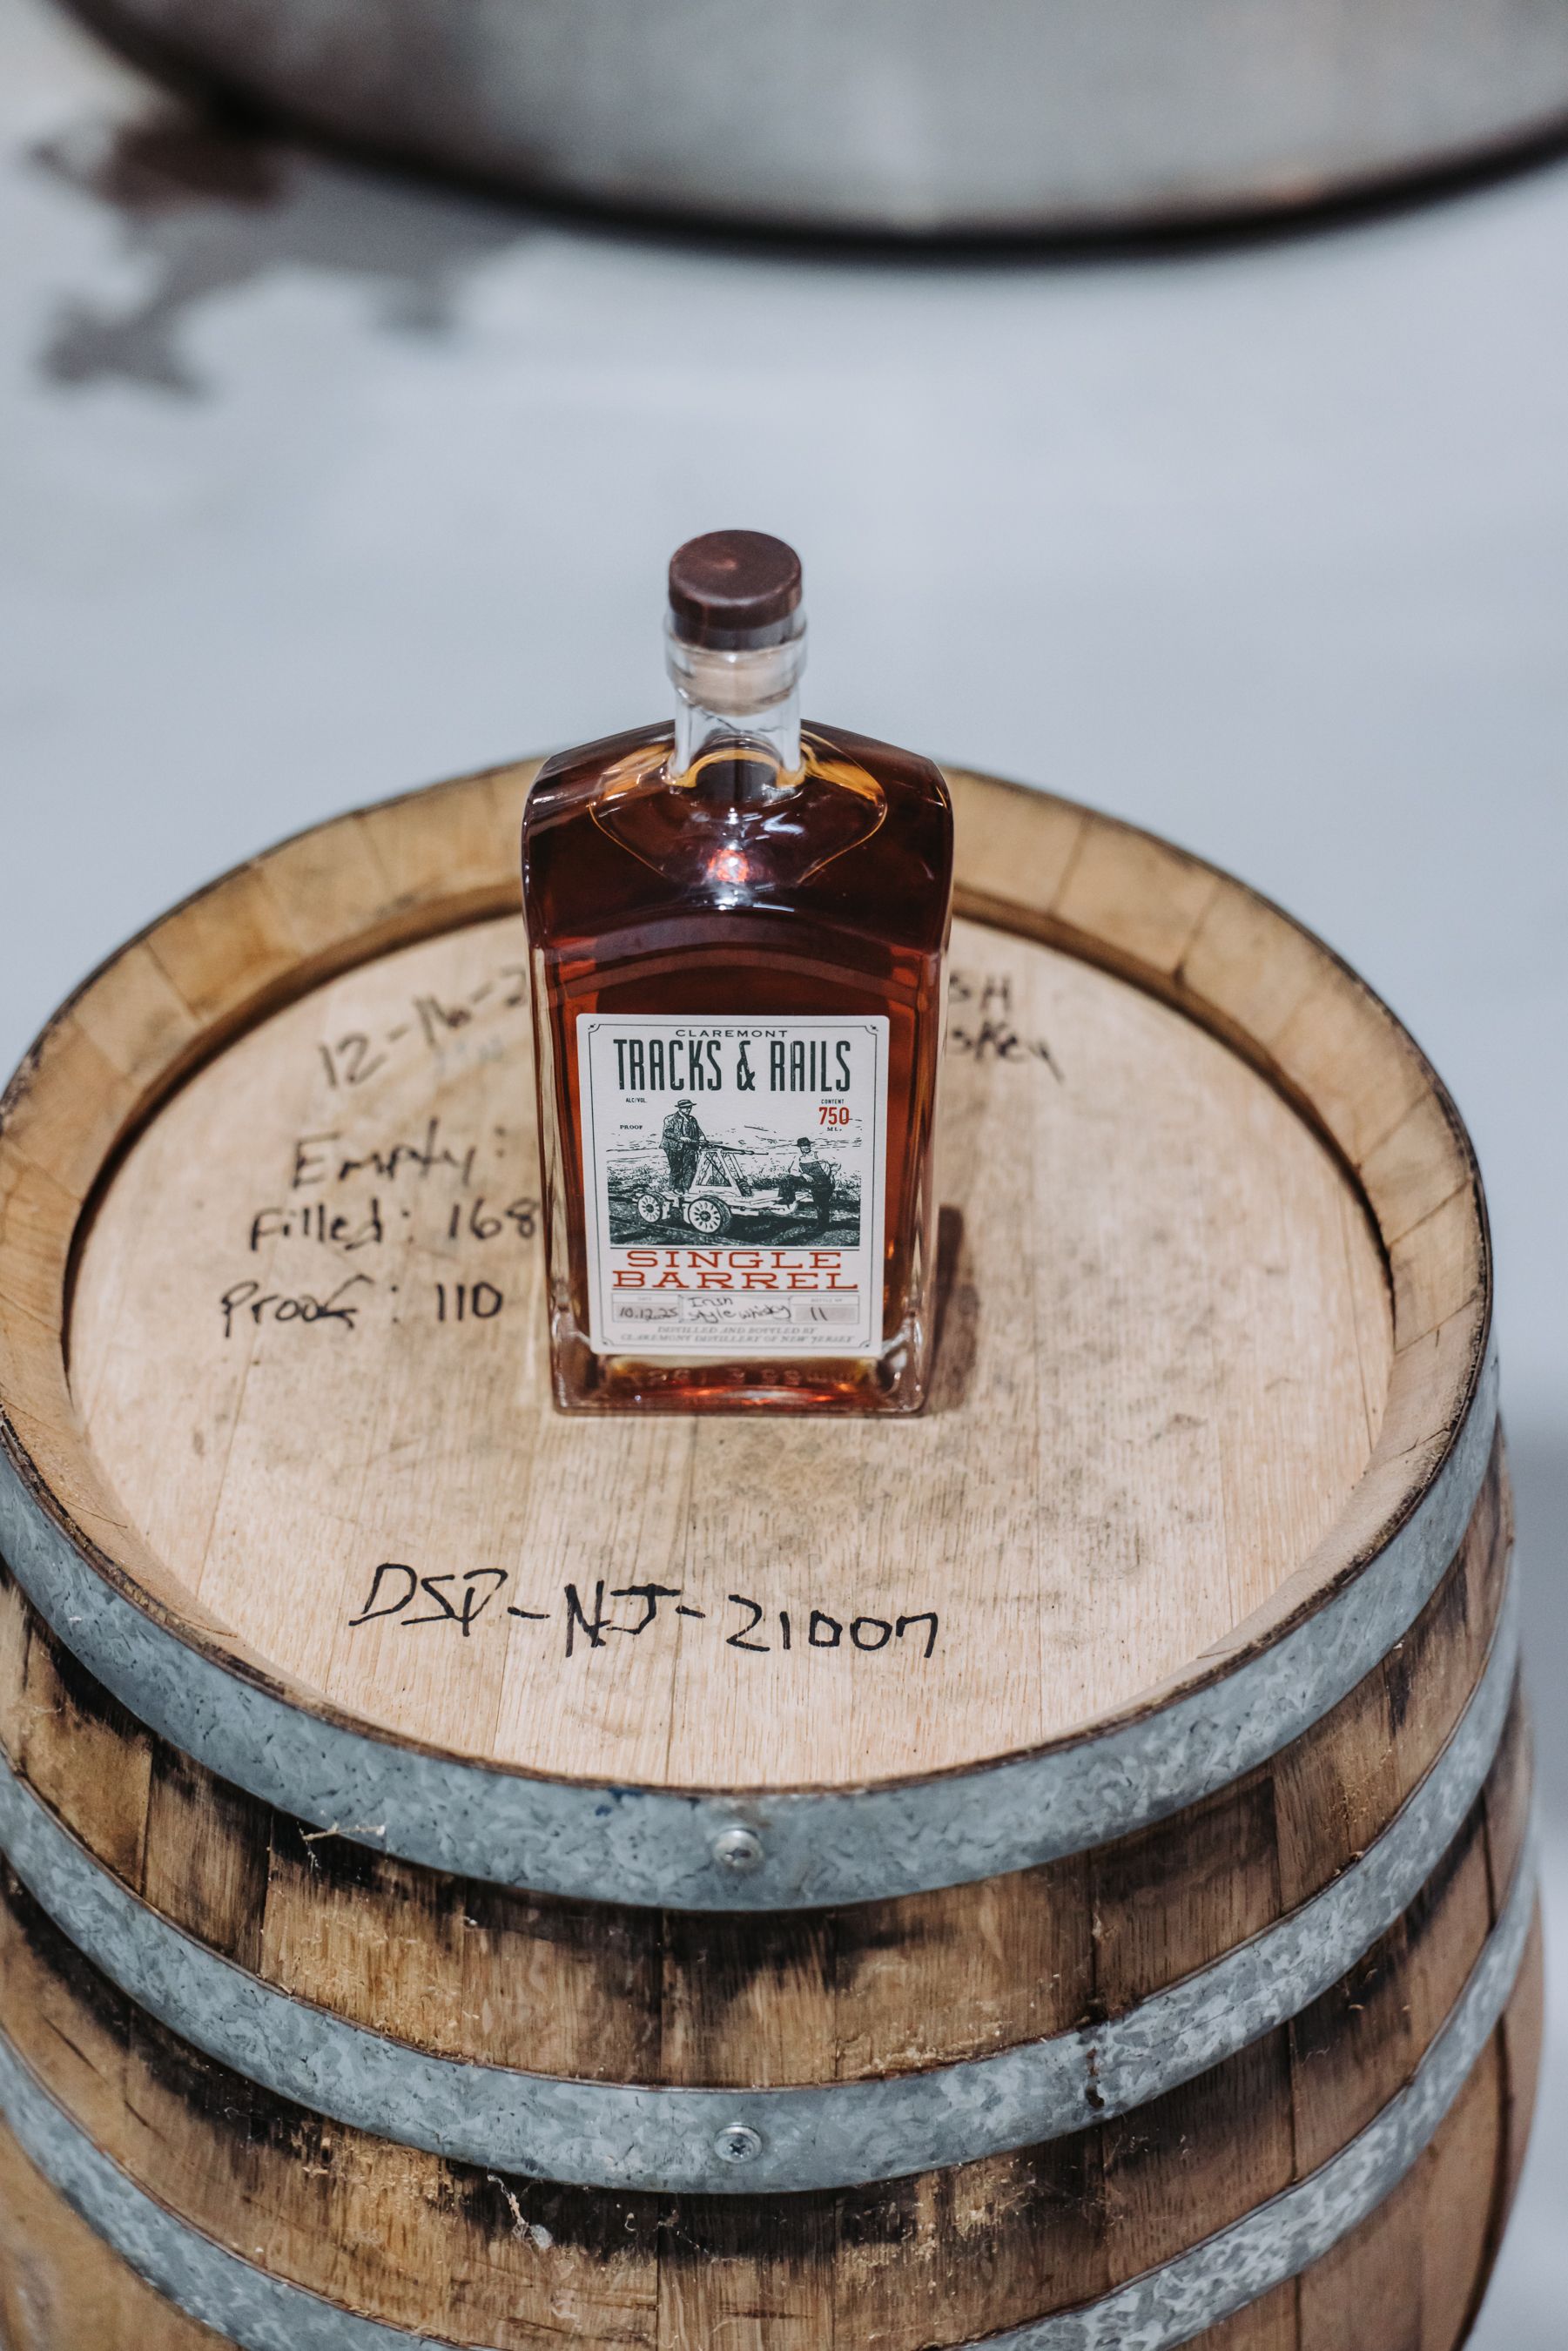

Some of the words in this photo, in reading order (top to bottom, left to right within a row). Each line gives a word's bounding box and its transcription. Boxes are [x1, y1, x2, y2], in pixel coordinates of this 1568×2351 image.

[676, 1029, 788, 1038] CLAREMONT
[613, 1039, 722, 1091] TRACKS
[737, 1040, 755, 1091] &
[771, 1041, 851, 1092] RAILS
[818, 1106, 850, 1125] 750
[448, 1197, 539, 1240] 168
[627, 1250, 842, 1269] SINGLE
[612, 1270, 858, 1290] BARREL
[436, 1282, 502, 1322] 110
[810, 1306, 828, 1321] 11
